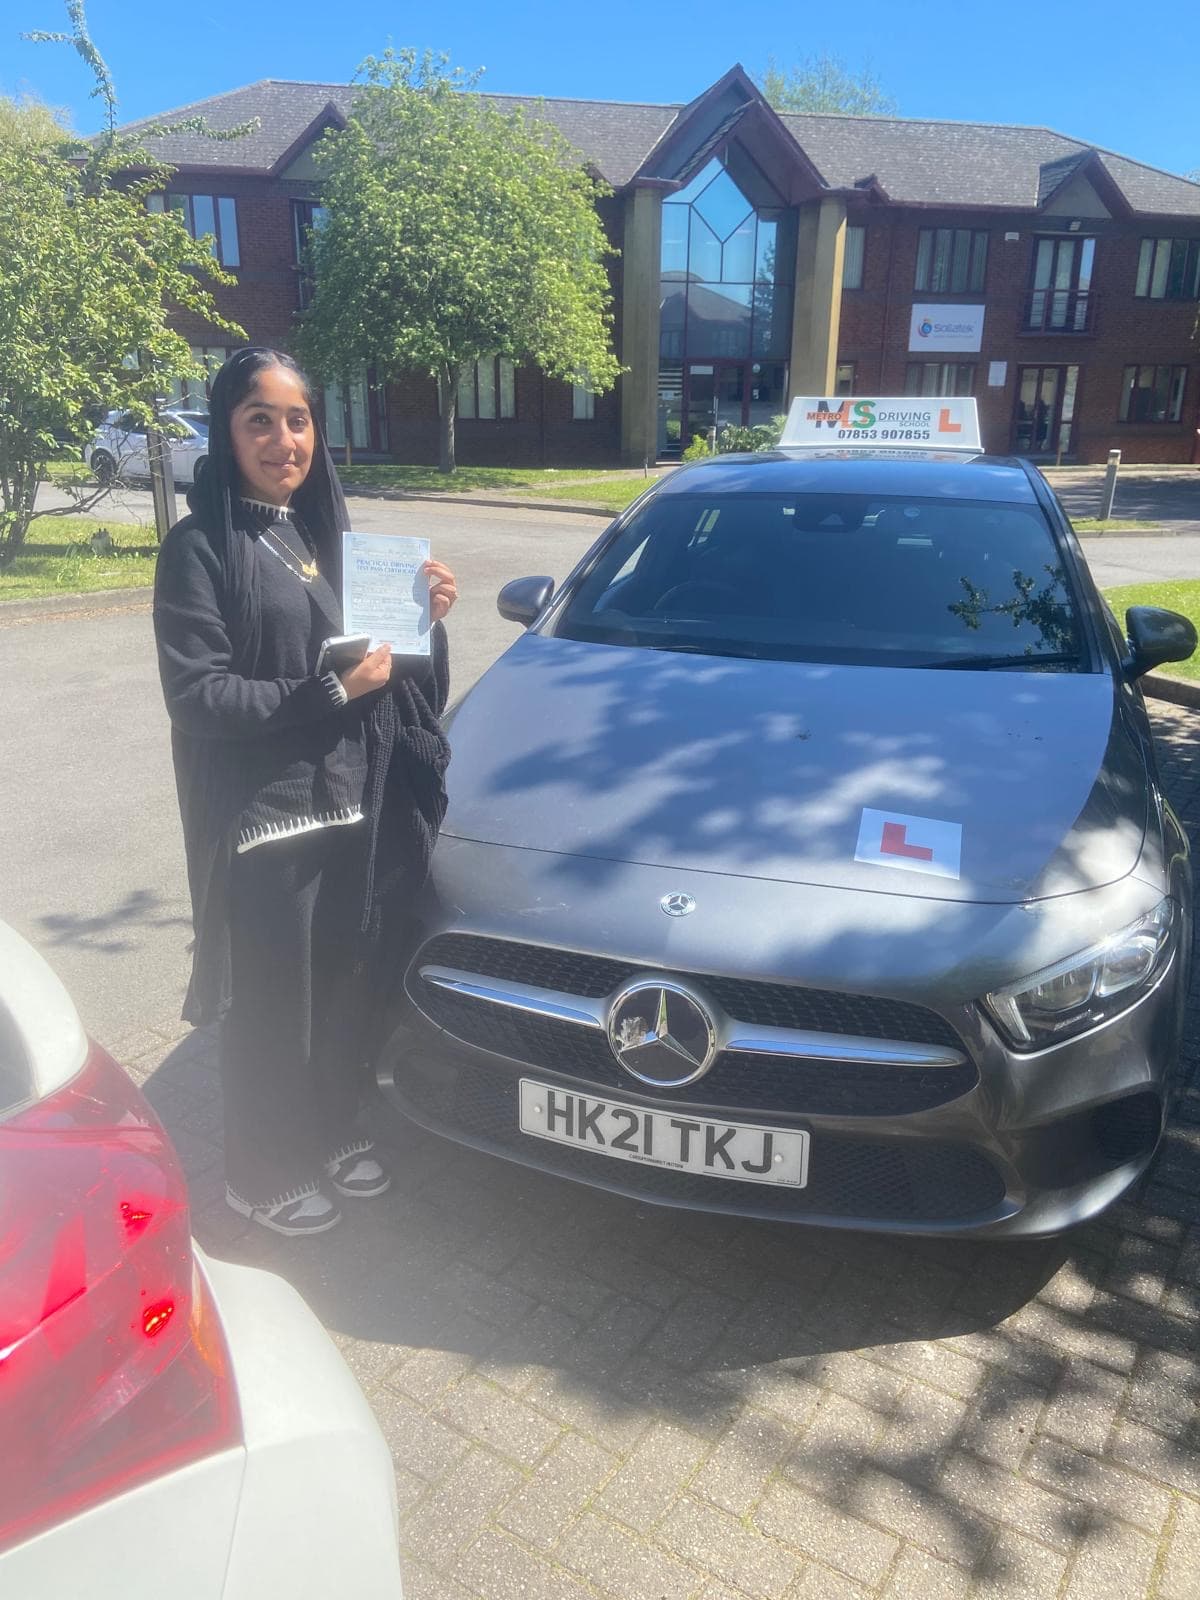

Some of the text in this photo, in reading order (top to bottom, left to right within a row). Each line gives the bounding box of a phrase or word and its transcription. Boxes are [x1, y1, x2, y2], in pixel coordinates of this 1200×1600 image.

[806, 412, 842, 421] METRO
[878, 411, 931, 421] DRIVING
[938, 408, 962, 433] L
[838, 429, 931, 440] 07853 907855
[356, 559, 417, 569] PRACTICAL DRIVING
[880, 821, 933, 862] L
[547, 1090, 774, 1174] HK21 TKJ
